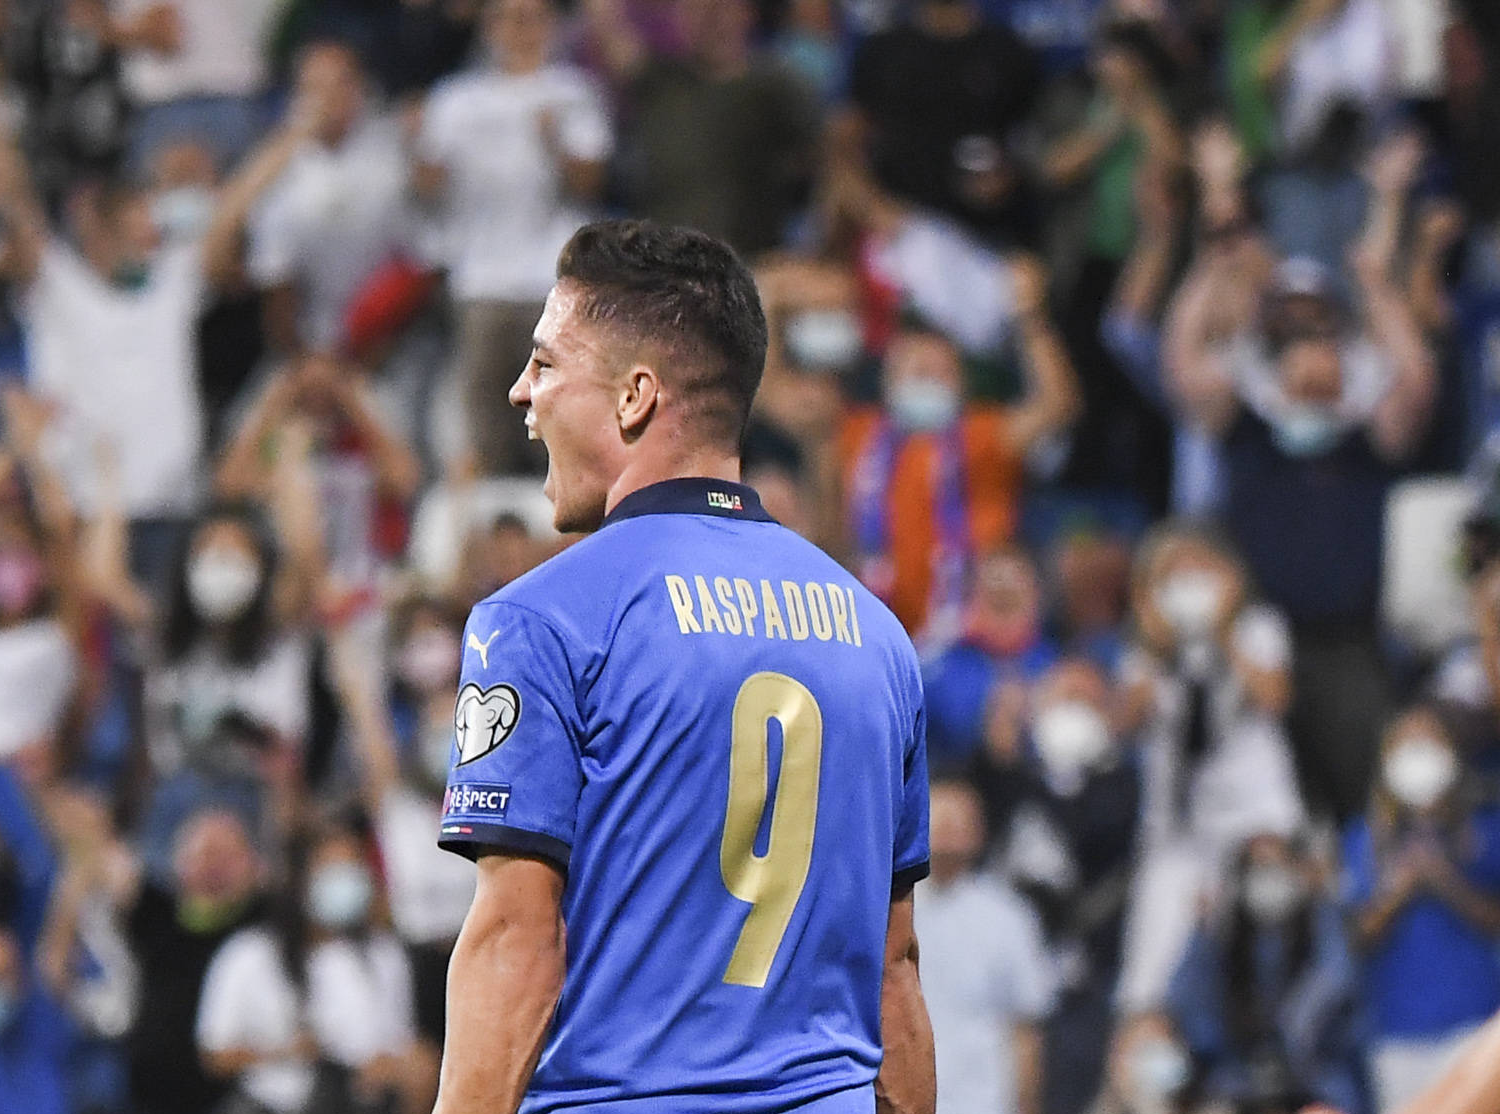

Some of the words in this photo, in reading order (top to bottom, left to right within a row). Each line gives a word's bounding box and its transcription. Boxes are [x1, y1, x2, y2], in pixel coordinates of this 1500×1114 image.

[707, 491, 741, 506] ITALIA
[665, 575, 862, 647] RASPADORI
[450, 791, 510, 809] RESPECT
[720, 671, 823, 988] 9
